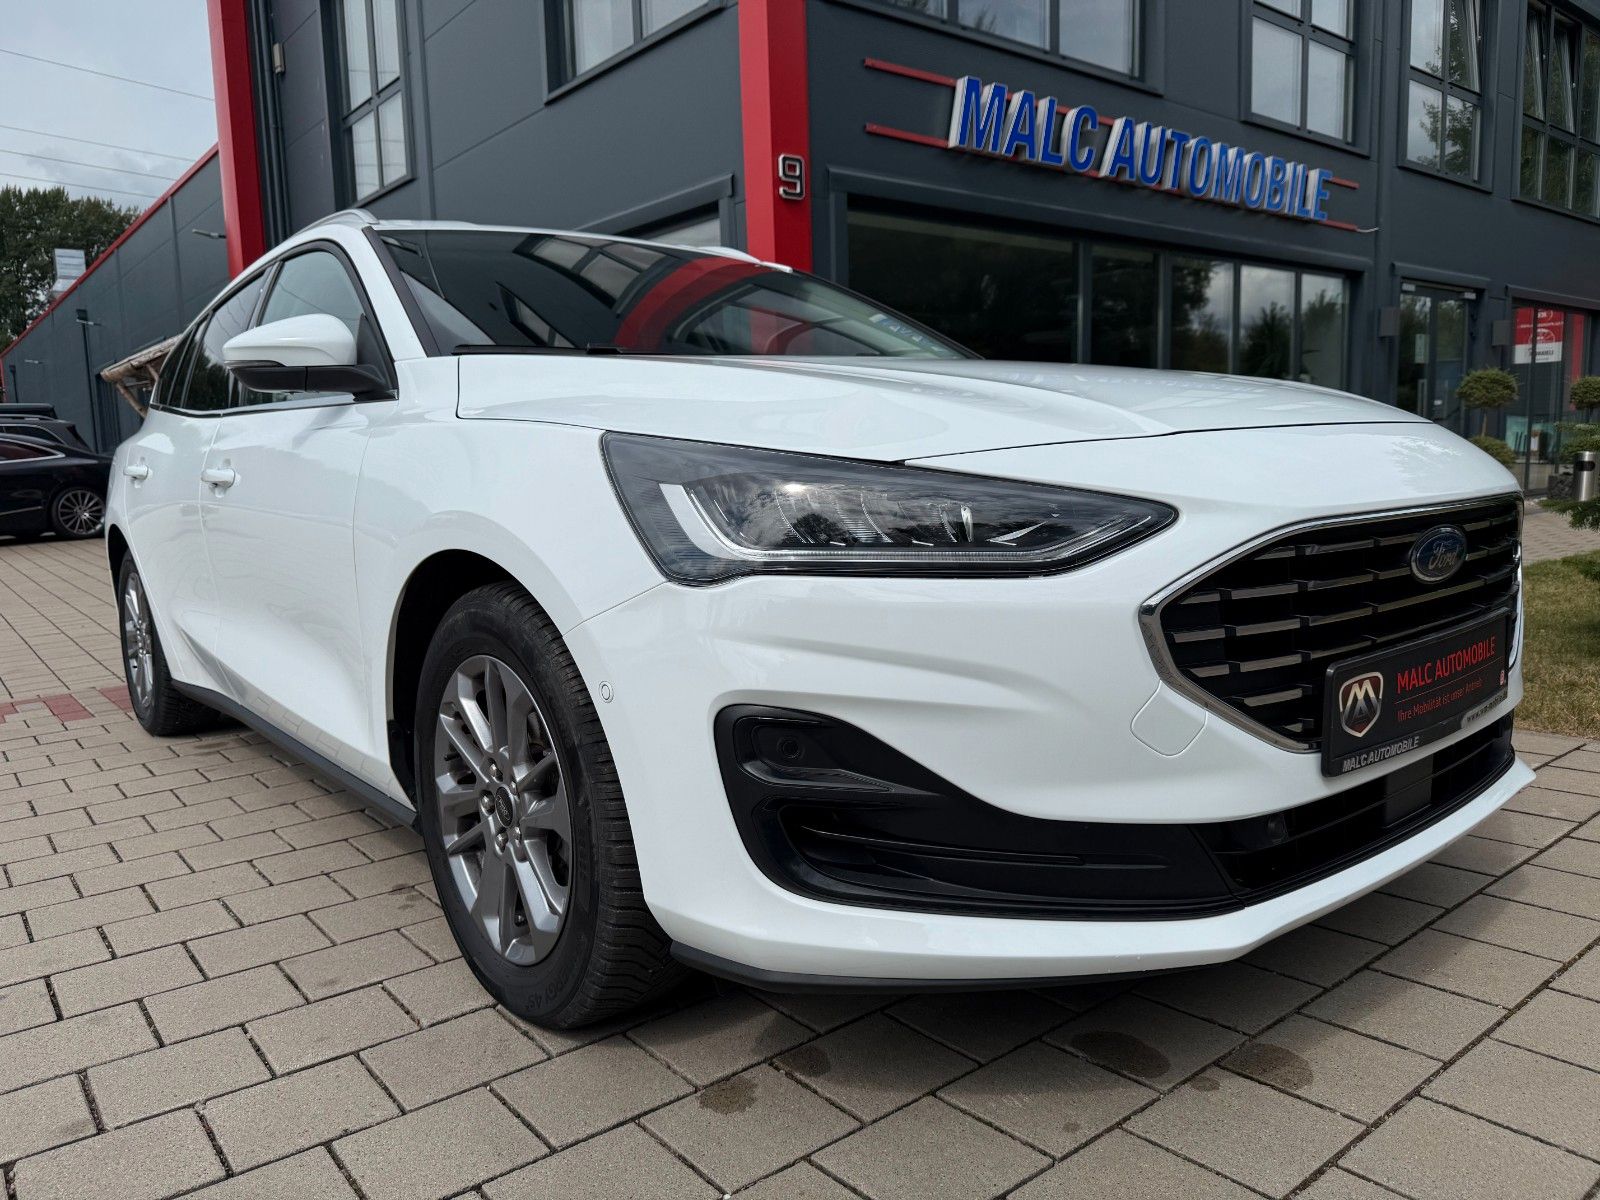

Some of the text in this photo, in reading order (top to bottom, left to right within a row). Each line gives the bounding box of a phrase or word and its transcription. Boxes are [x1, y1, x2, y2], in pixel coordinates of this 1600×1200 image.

[949, 75, 1333, 222] MALC AUTOMOBILE
[778, 153, 805, 200] 9
[1428, 540, 1460, 571] Ford
[1397, 636, 1496, 695] MALC AUTOMOBILE
[1397, 707, 1413, 722] Ihre
[1413, 695, 1442, 717] Mobilität
[1342, 736, 1420, 772] MALC AUTOMOBILE
